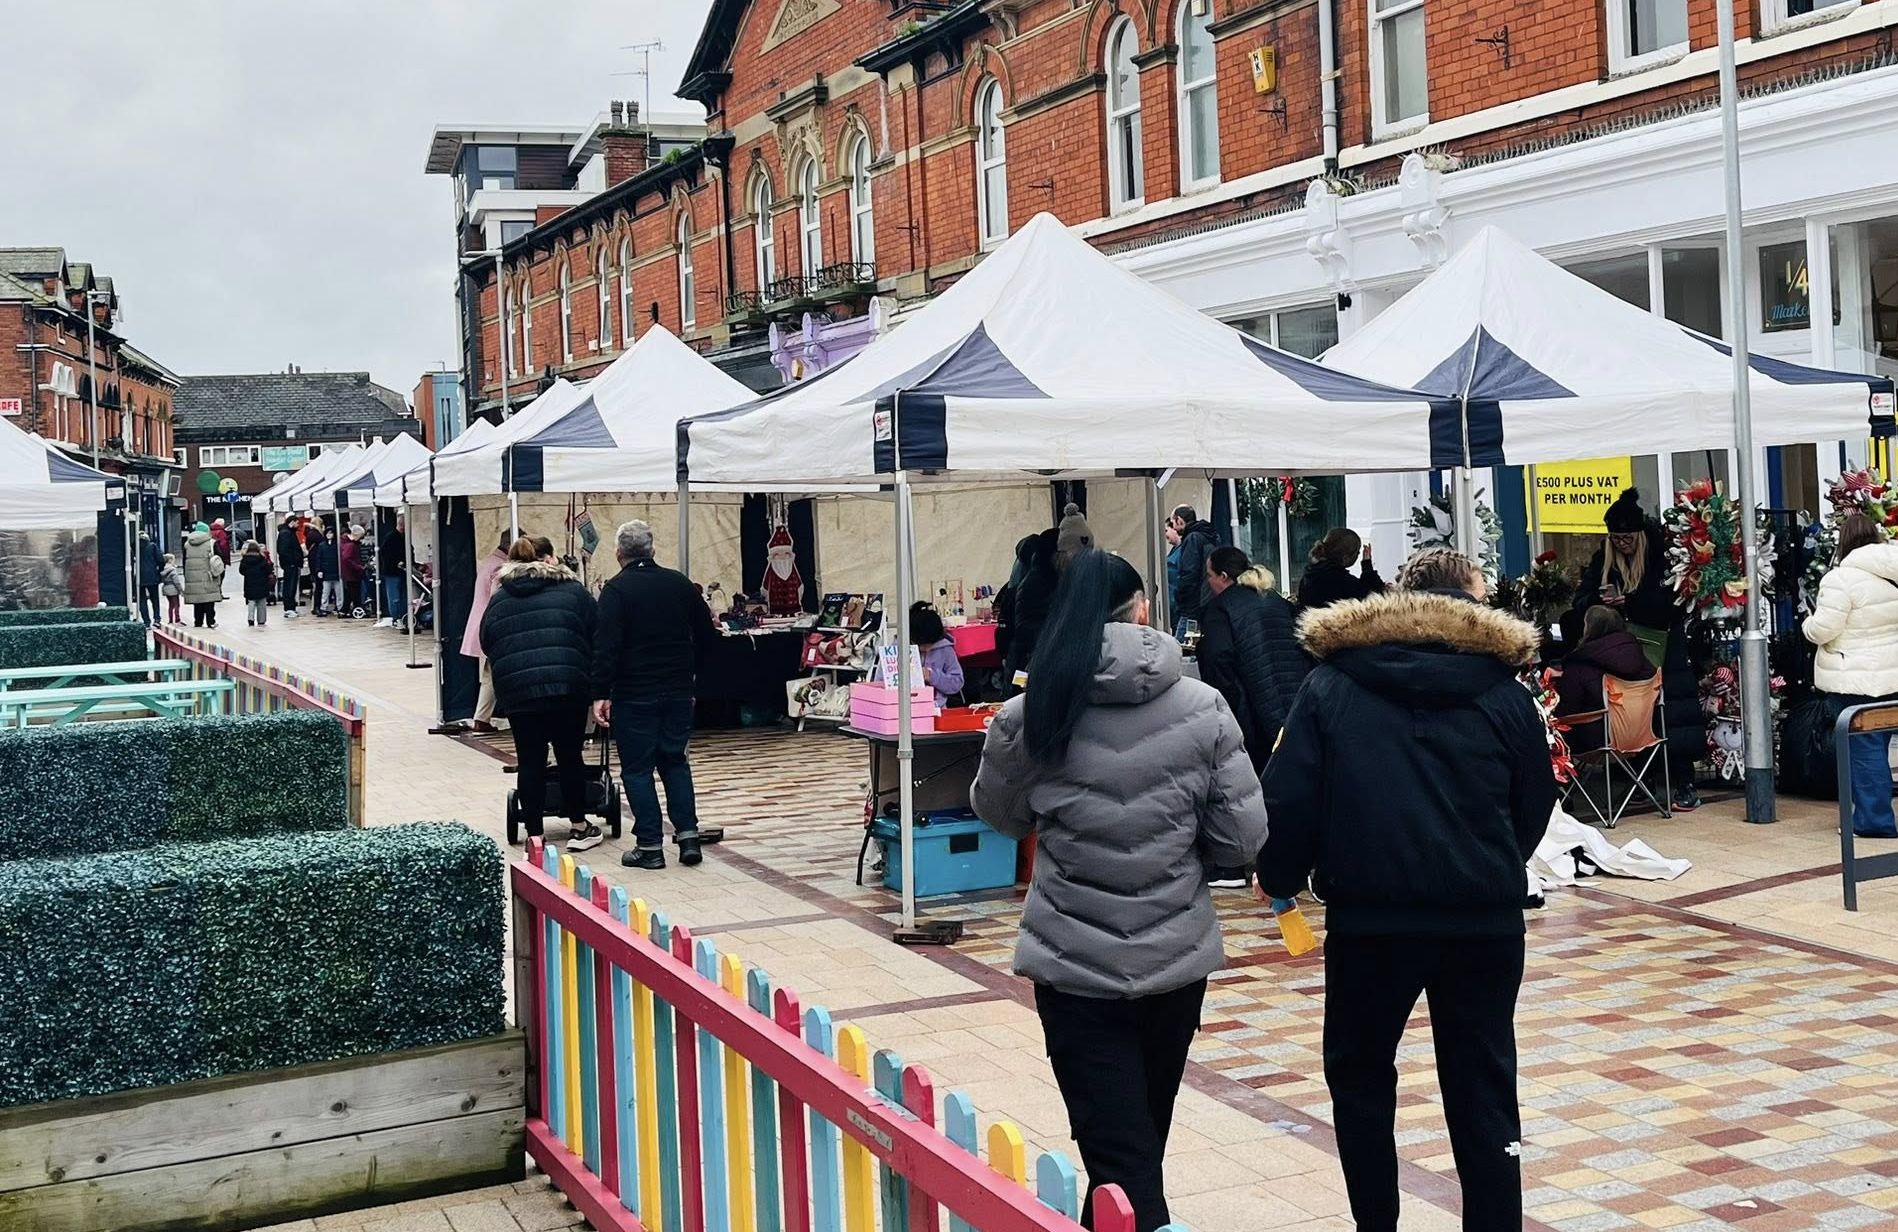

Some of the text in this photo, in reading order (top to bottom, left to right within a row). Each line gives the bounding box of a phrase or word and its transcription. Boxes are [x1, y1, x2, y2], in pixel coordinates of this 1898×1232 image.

[1771, 301, 1809, 320] Marke
[0, 401, 19, 410] AFE
[1536, 476, 1619, 488] £500 PLUS VAT
[1544, 493, 1612, 504] PER MONTH
